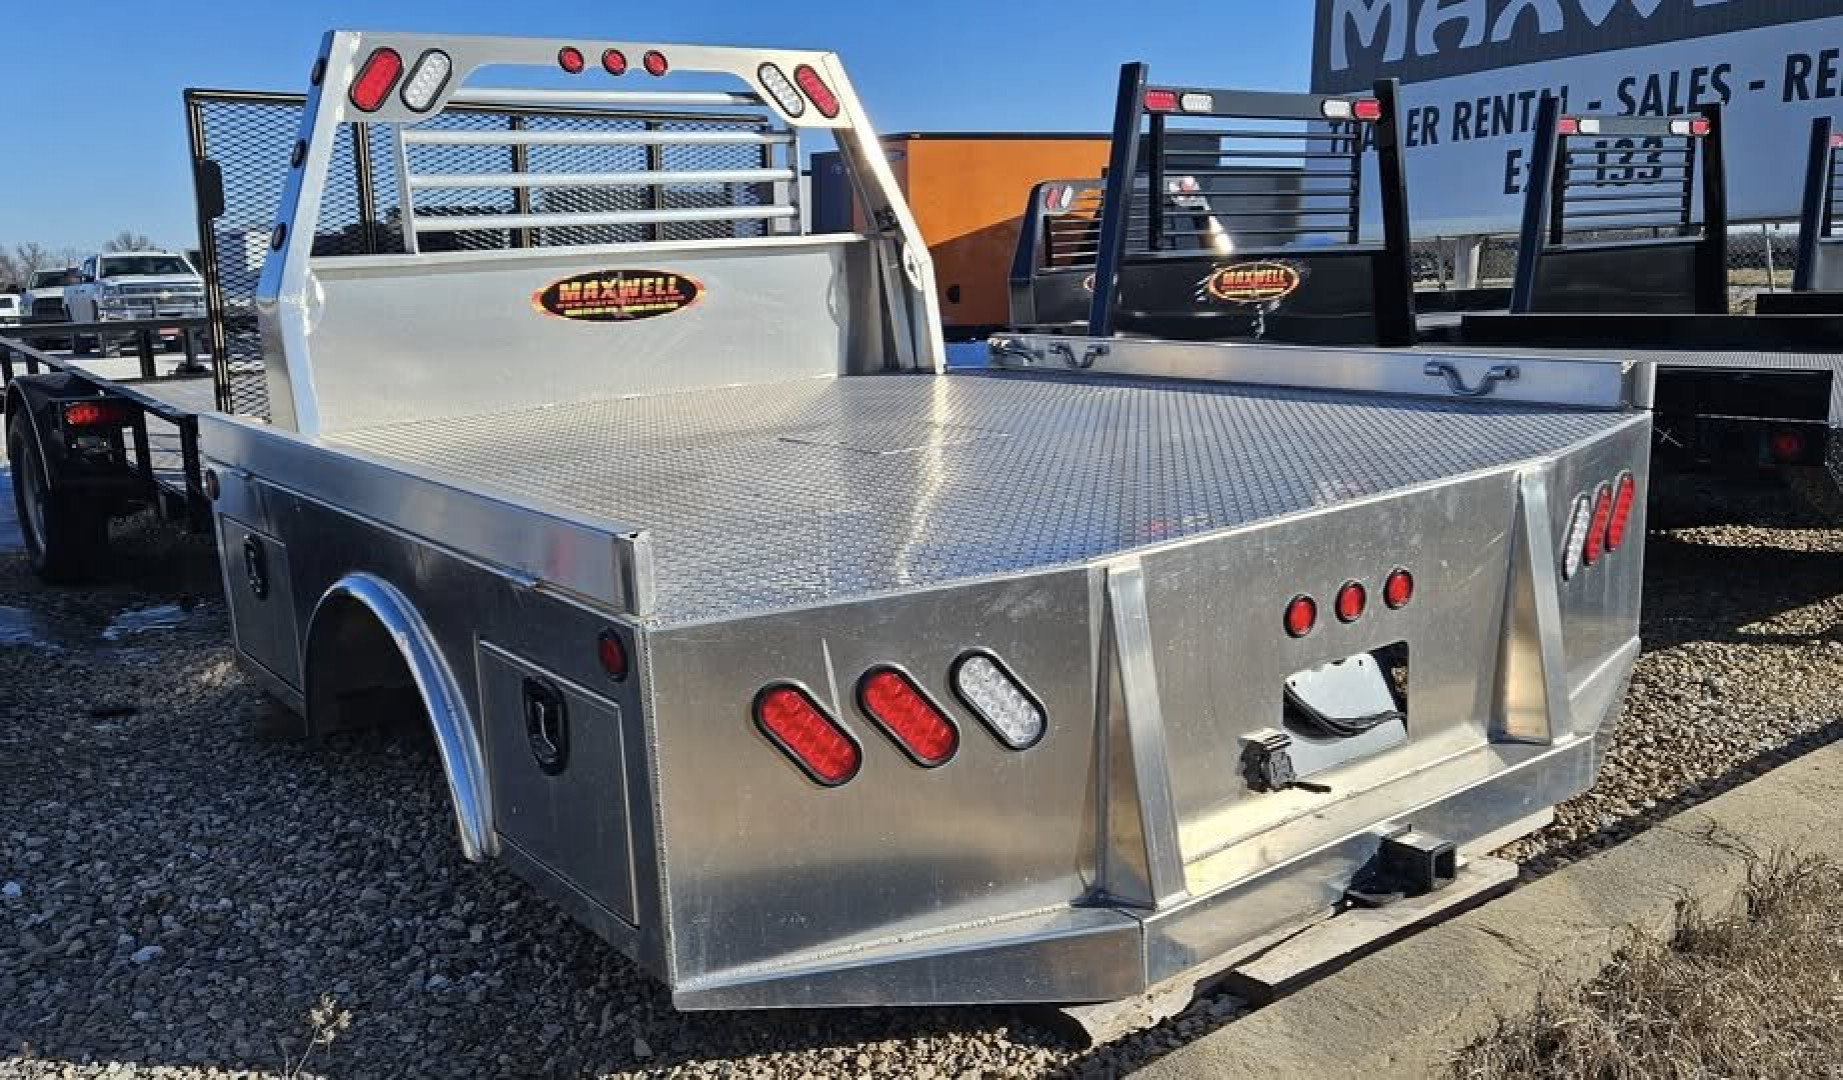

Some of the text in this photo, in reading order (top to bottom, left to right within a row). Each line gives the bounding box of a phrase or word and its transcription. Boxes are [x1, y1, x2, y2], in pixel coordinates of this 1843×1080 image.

[1331, 0, 1728, 71] MAX
[1329, 106, 1440, 152] TAER
[1452, 86, 1569, 141] RENTL
[1617, 63, 1732, 117] SALES
[1782, 48, 1843, 103] RE
[1595, 135, 1664, 187] 133
[559, 277, 680, 301] MAXWELL
